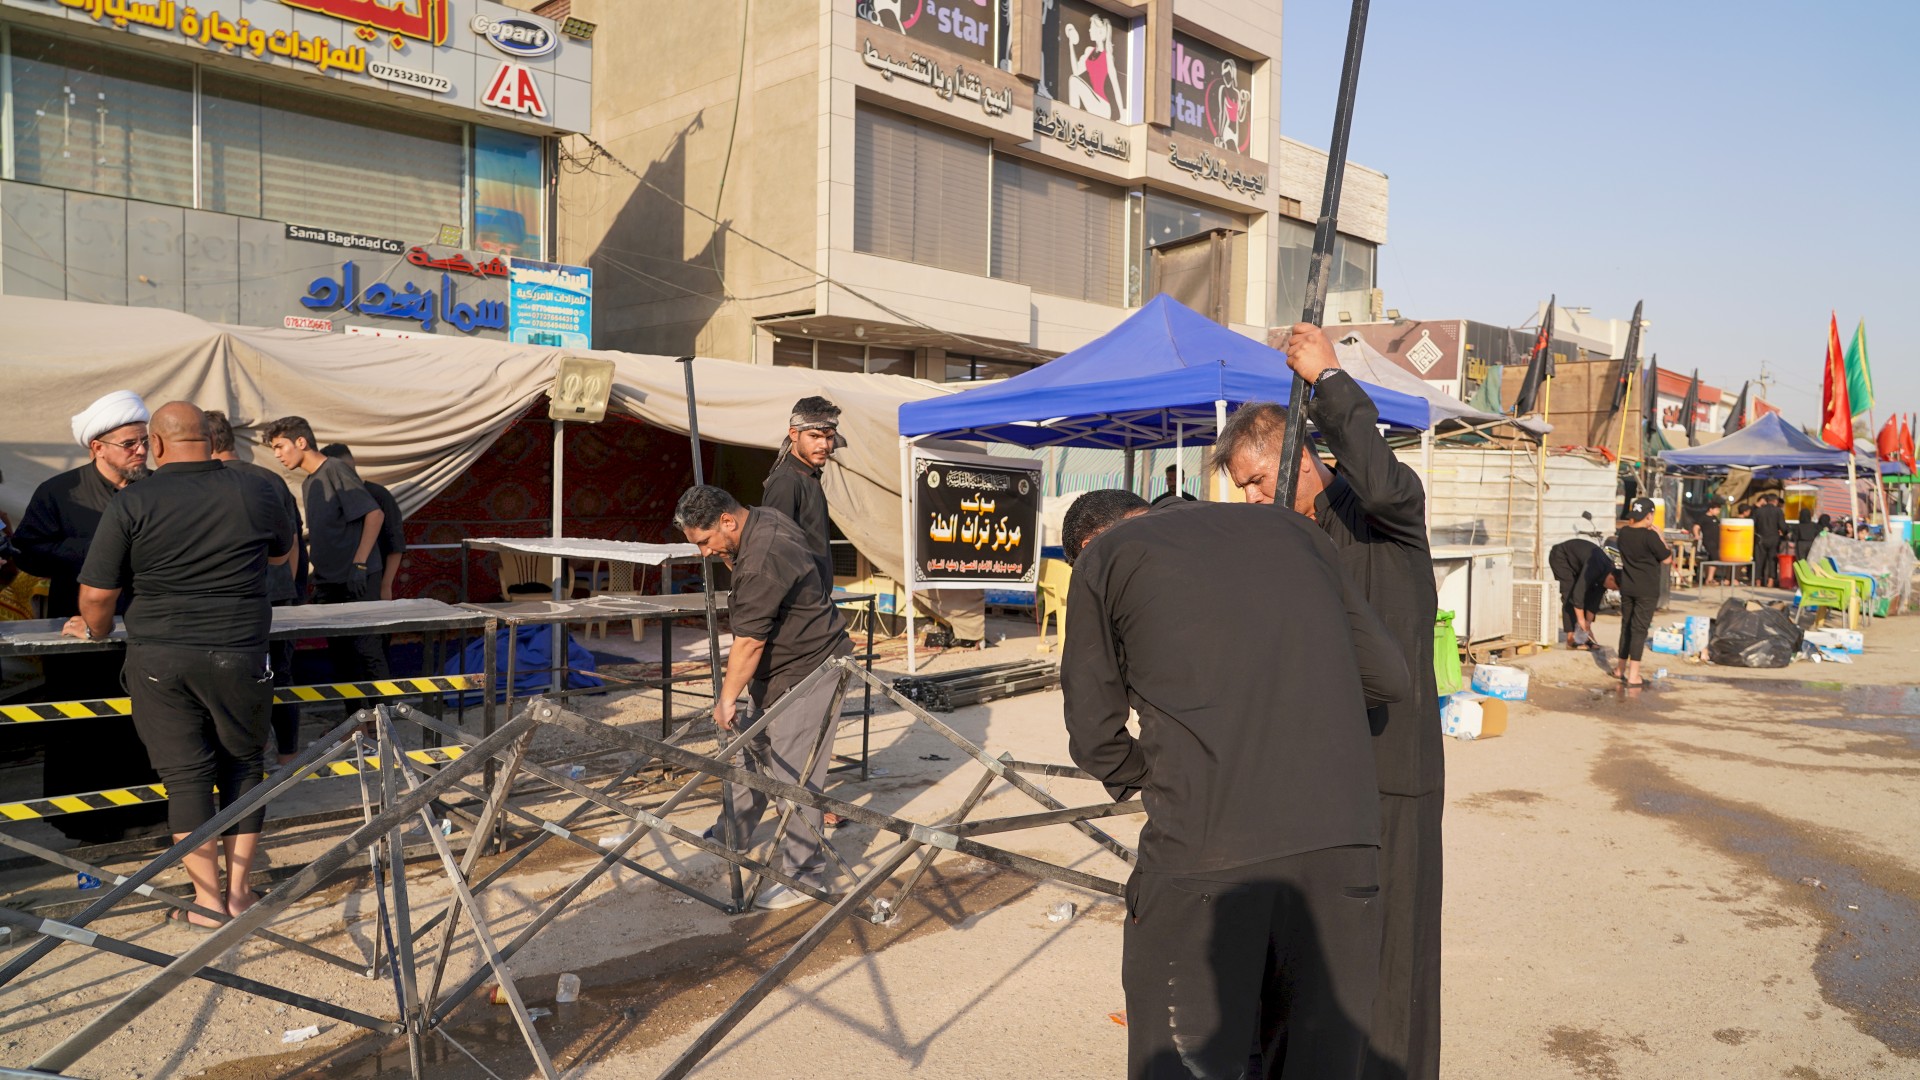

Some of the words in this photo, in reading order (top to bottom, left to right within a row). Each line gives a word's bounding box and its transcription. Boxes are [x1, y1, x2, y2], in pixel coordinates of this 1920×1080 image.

[181, 7, 266, 57] وتجارة
[473, 14, 546, 46] Copart
[937, 6, 990, 47] star
[267, 29, 366, 73] للمزادات
[372, 64, 448, 89] 07753230772
[983, 85, 1012, 115] البيع
[289, 226, 326, 241] Sama
[327, 231, 381, 249] Baghdad
[382, 240, 401, 252] Co.
[405, 246, 508, 277] شركة
[300, 260, 434, 331] بغداد
[440, 271, 505, 332] سما
[960, 492, 996, 516] موكب
[930, 512, 959, 543] الحلة
[961, 515, 990, 551] تراث
[991, 516, 1022, 552] مركز
